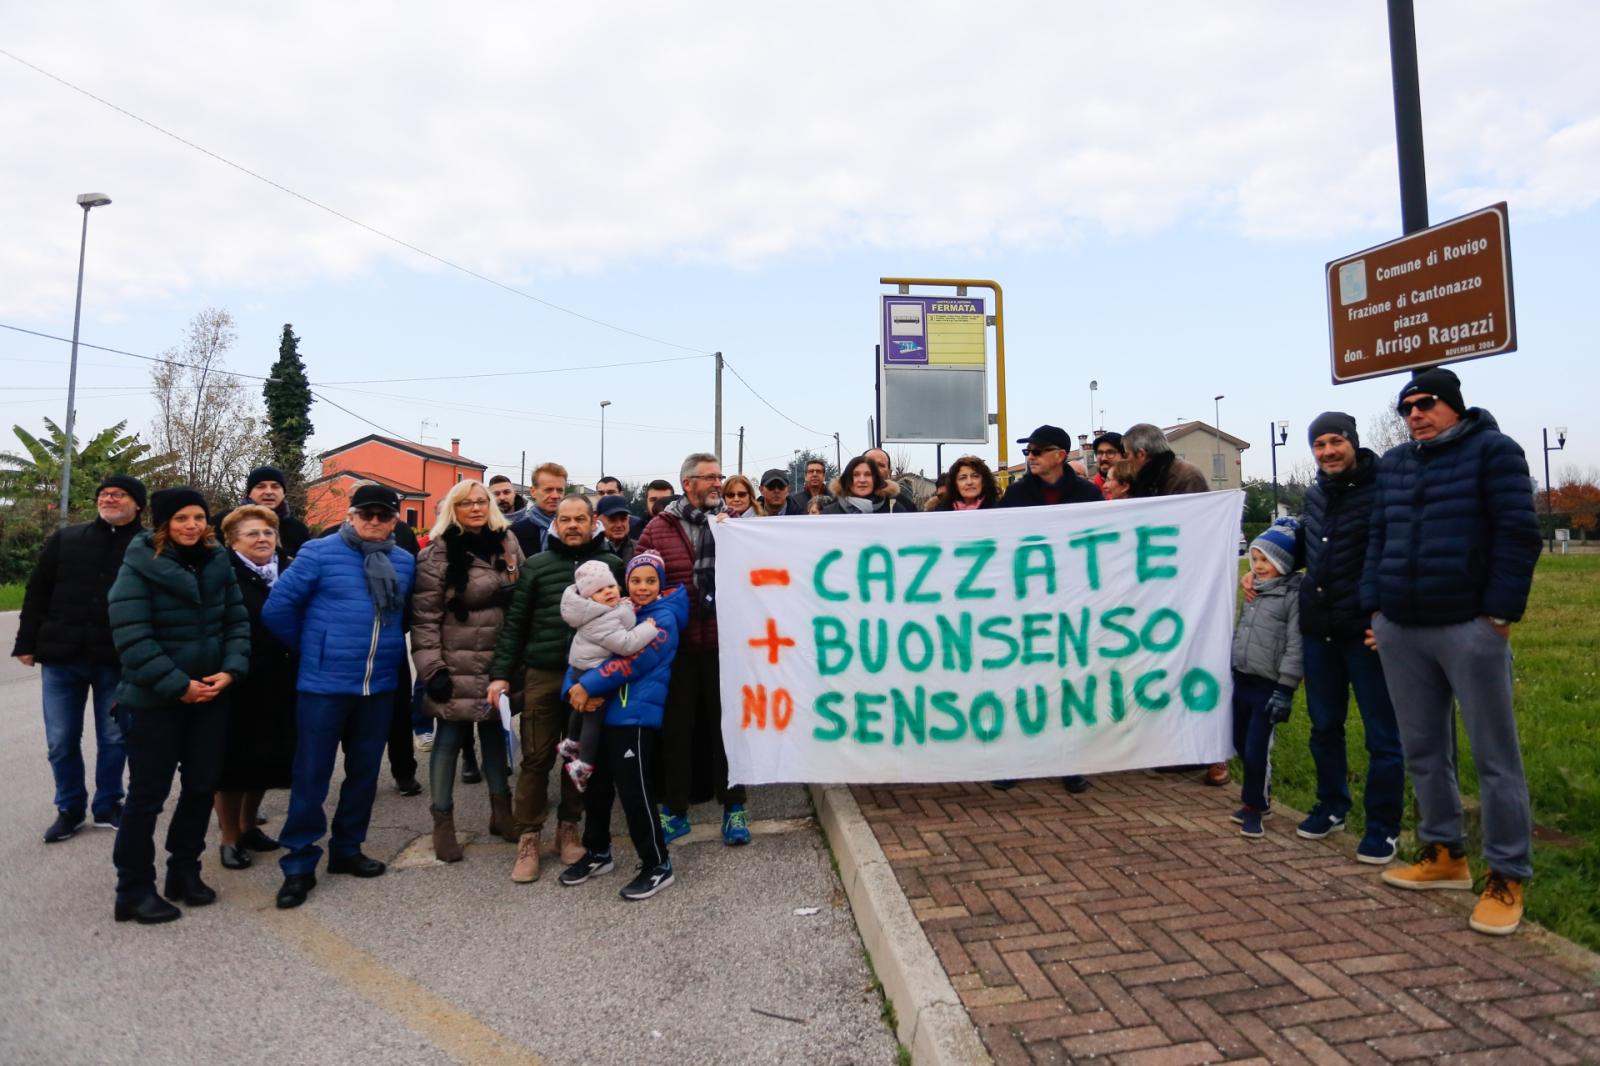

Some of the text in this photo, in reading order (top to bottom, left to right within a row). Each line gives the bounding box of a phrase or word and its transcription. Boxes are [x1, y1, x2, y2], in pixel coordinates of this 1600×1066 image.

[1376, 238, 1488, 281] Comune di Rovigo
[931, 303, 976, 313] FERMATA
[1347, 275, 1482, 321] Frazione di Cantonazzo
[1375, 333, 1421, 357] Arrigo
[1428, 312, 1494, 345] Ragazzi
[1393, 311, 1429, 332] piazza
[811, 524, 1181, 606] CAZZATE
[811, 604, 1186, 678] BUONSENSO
[741, 683, 795, 732] NO
